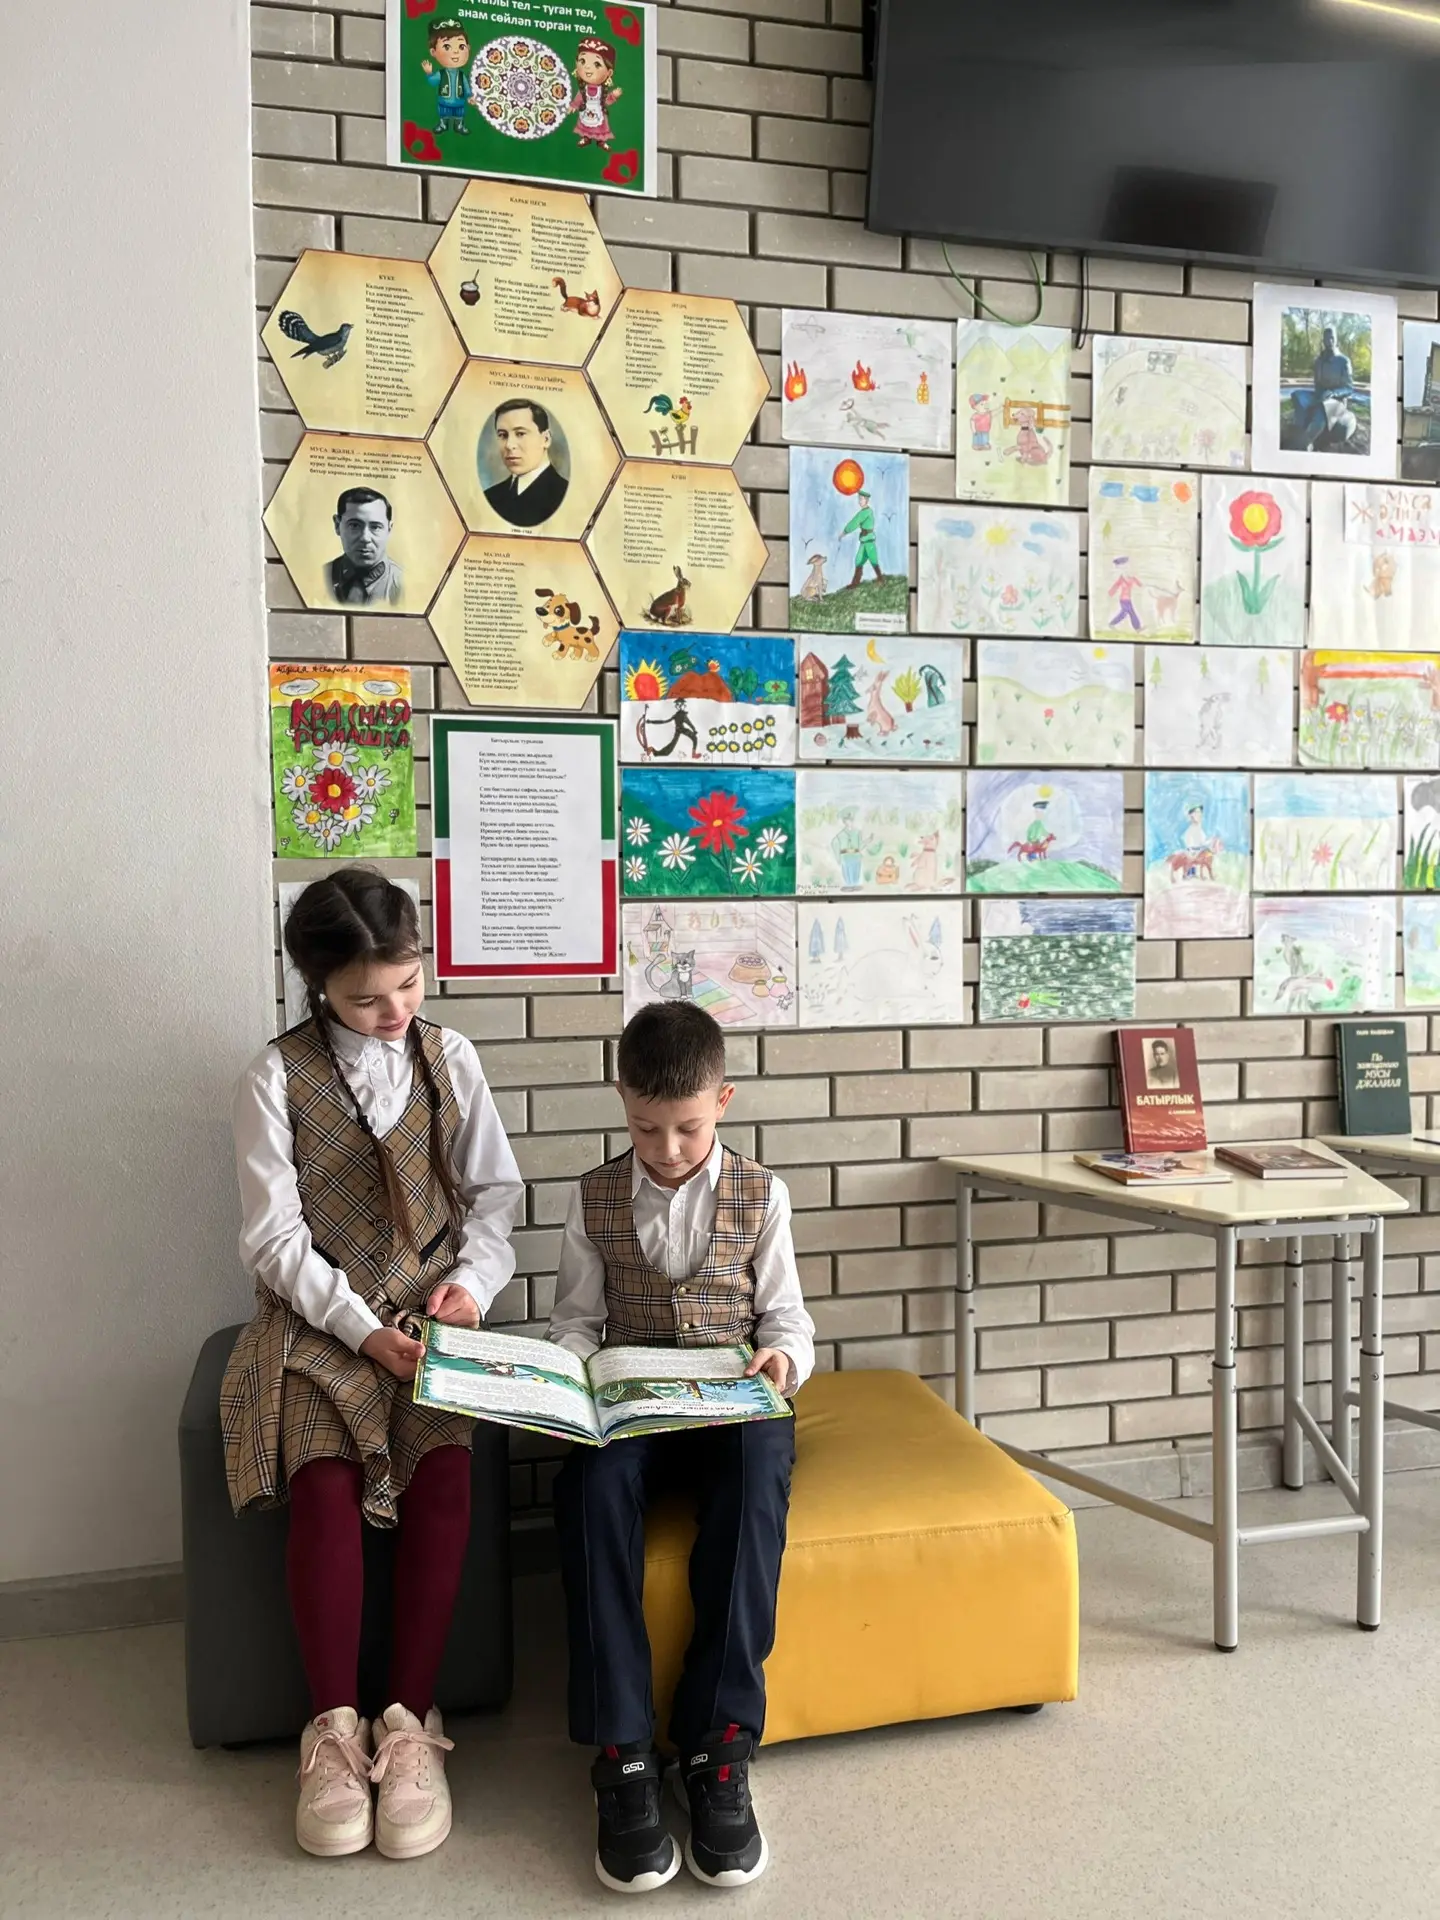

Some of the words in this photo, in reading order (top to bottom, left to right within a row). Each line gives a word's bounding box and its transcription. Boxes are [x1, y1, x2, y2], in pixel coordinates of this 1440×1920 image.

[512, 1, 530, 11] тел
[543, 5, 572, 16] туган
[575, 8, 596, 20] тел,
[458, 8, 488, 20] анам
[490, 13, 531, 27] сөйләп
[534, 20, 571, 31] торган
[574, 24, 596, 34] тел.
[291, 698, 411, 729] КРАСНАЯ
[293, 728, 410, 753] РОМАШКА
[1371, 1053, 1383, 1061] По
[1365, 1070, 1391, 1079] МУСЫ
[1355, 1078, 1401, 1090] ДЖАЛИЛЯ
[1136, 1094, 1195, 1106] БАТЫРЛЫК
[690, 1753, 708, 1765] GSD
[622, 1761, 645, 1774] GSD
